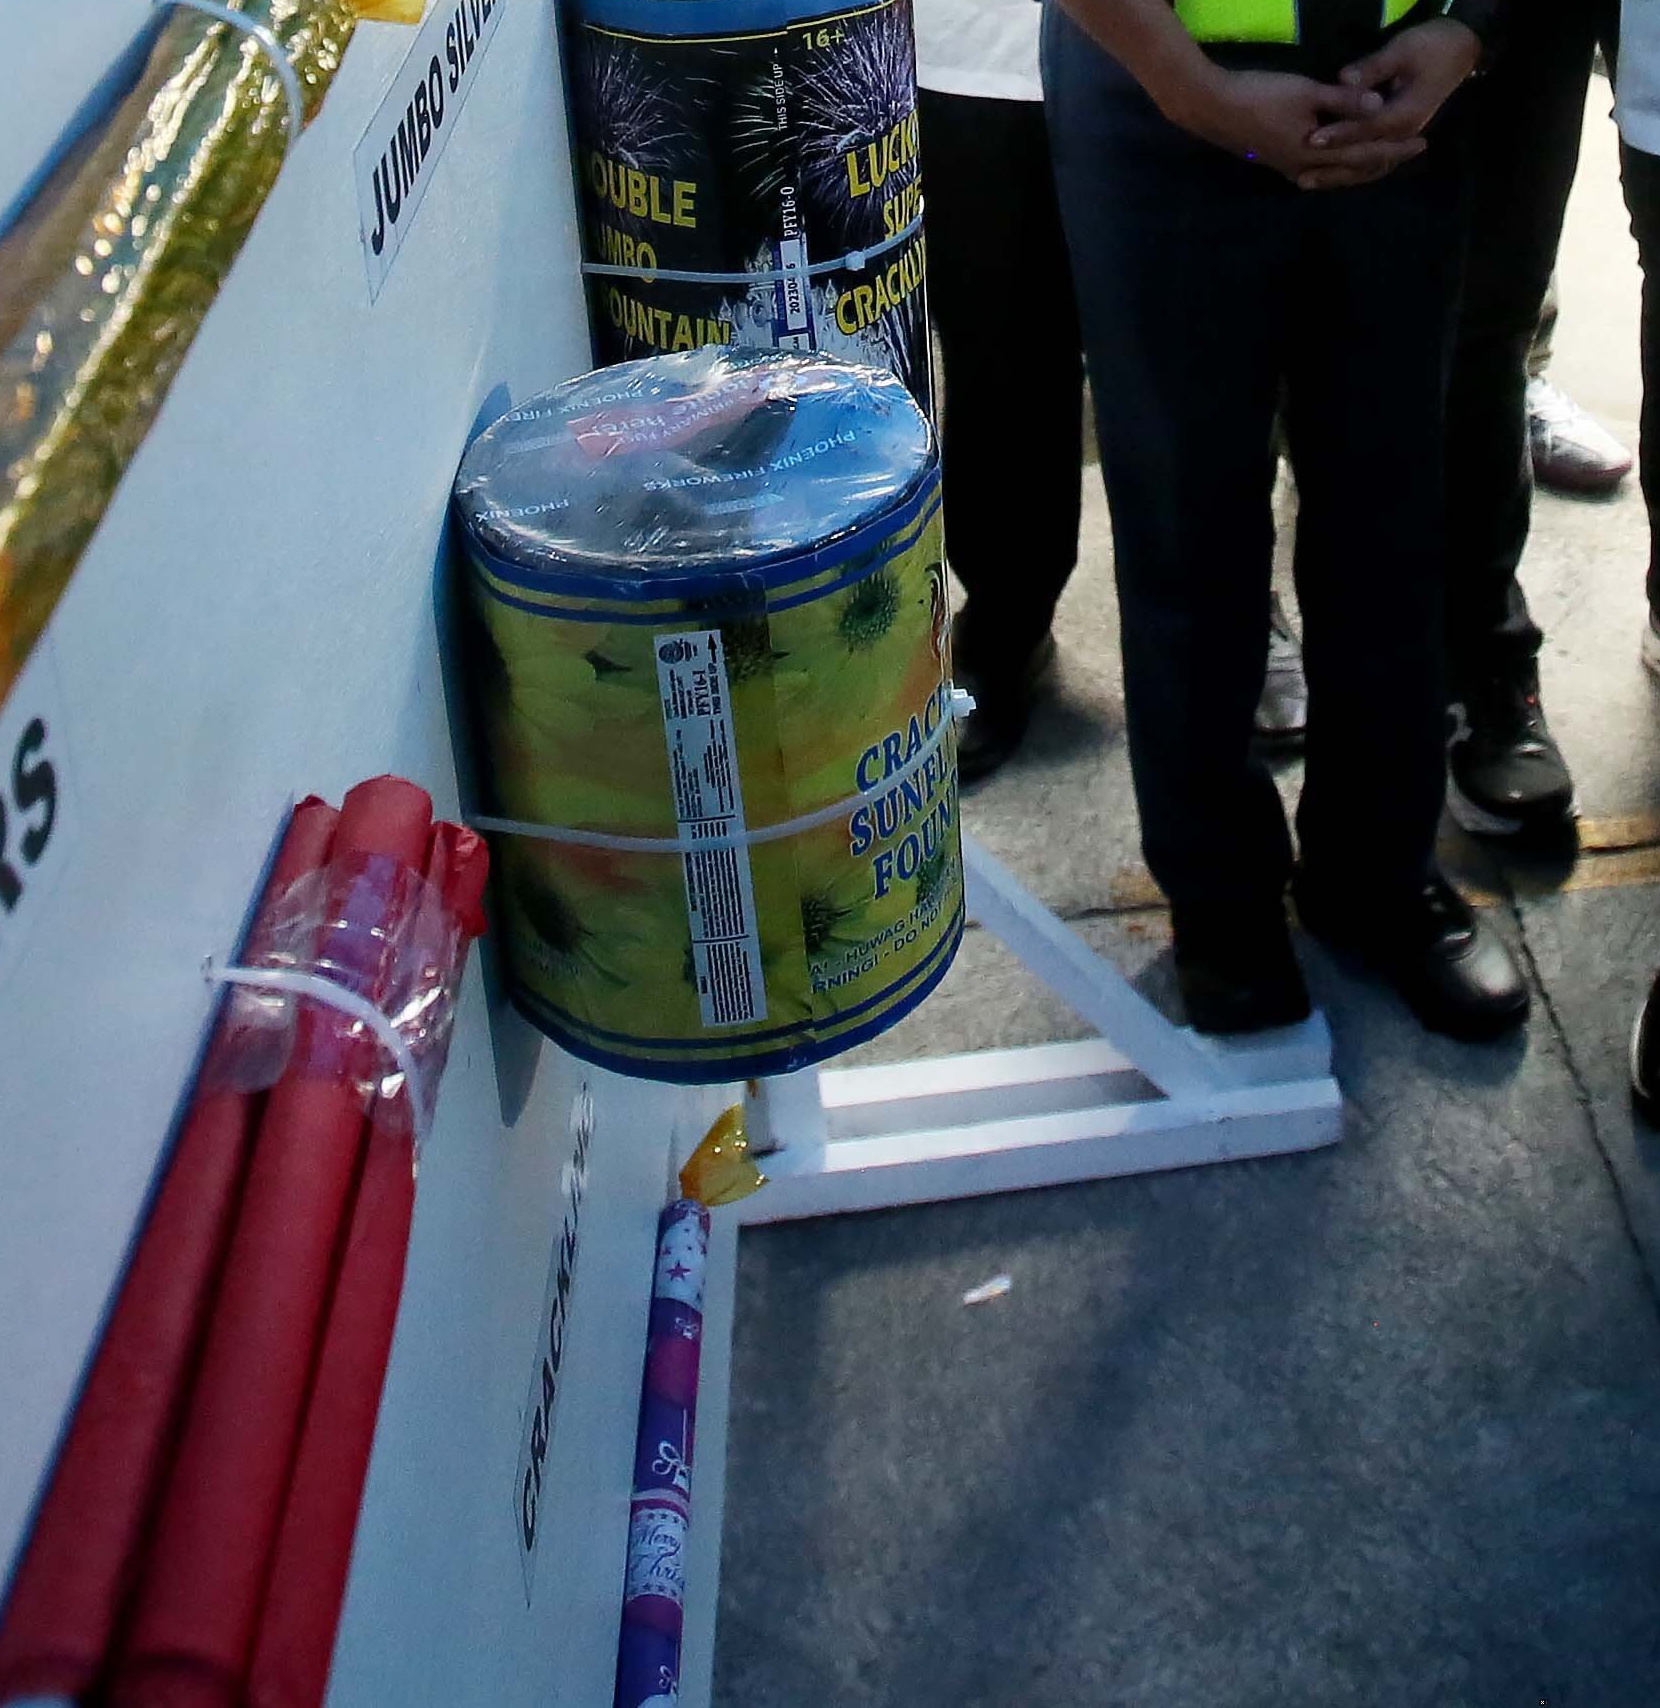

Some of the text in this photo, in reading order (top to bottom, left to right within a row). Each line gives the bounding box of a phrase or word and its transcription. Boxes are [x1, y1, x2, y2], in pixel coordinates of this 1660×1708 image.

[803, 27, 844, 51] 16+
[773, 62, 789, 131] THIS SIDE UP
[371, 55, 444, 256] JUMBO
[591, 150, 697, 229] OUBLE
[609, 286, 732, 352] OUNTAIN
[642, 429, 857, 490] PHOENIX FIREWORKS
[476, 498, 570, 523] PHOENIX
[845, 917, 906, 965] HUWAG
[893, 928, 918, 953] DO
